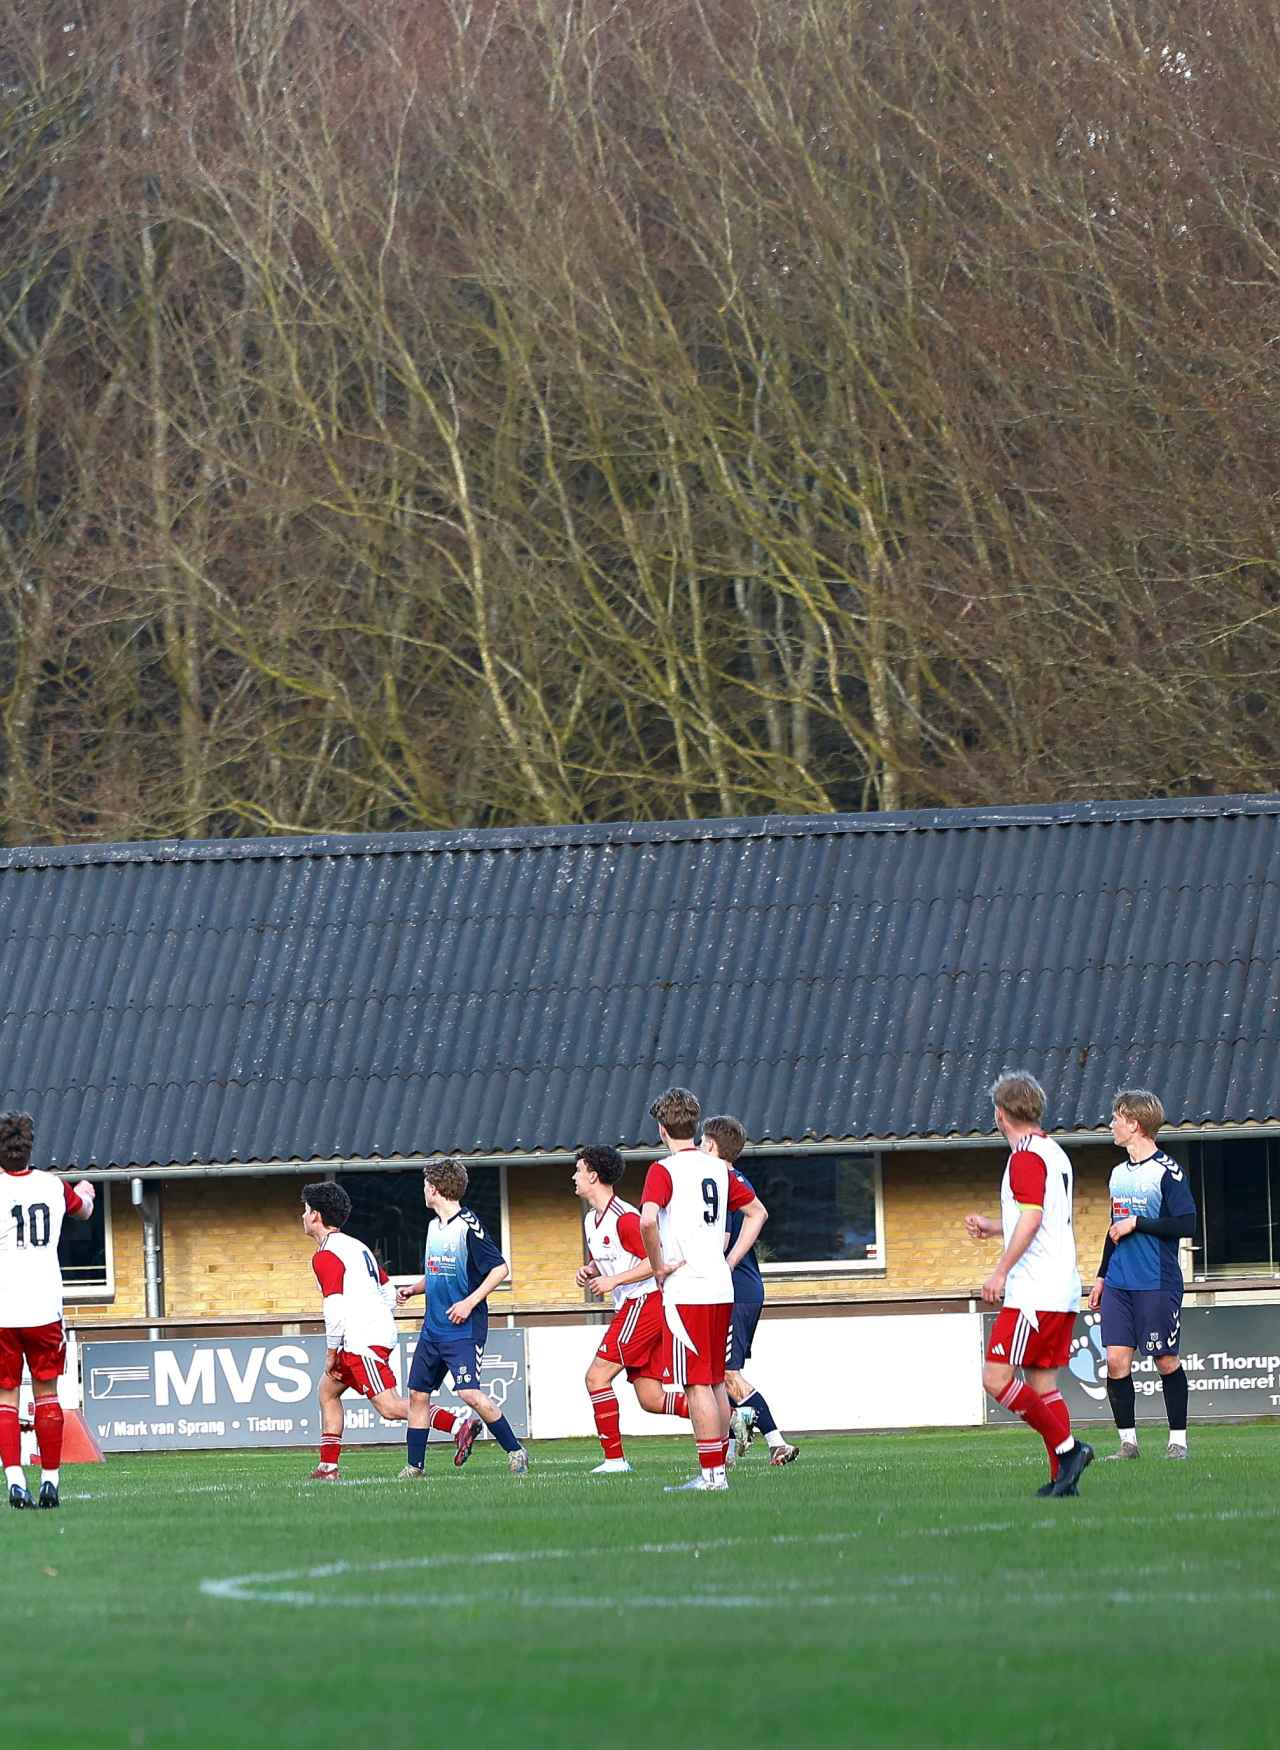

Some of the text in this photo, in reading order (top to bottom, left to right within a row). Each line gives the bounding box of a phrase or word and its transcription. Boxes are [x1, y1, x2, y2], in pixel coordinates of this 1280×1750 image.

[10, 1202, 50, 1248] 10
[700, 1177, 719, 1226] 9
[153, 1344, 313, 1407] MVS
[113, 1420, 147, 1437] Mark
[151, 1420, 174, 1436] van
[177, 1418, 225, 1437] Sprang
[246, 1416, 293, 1433] Tistrup
